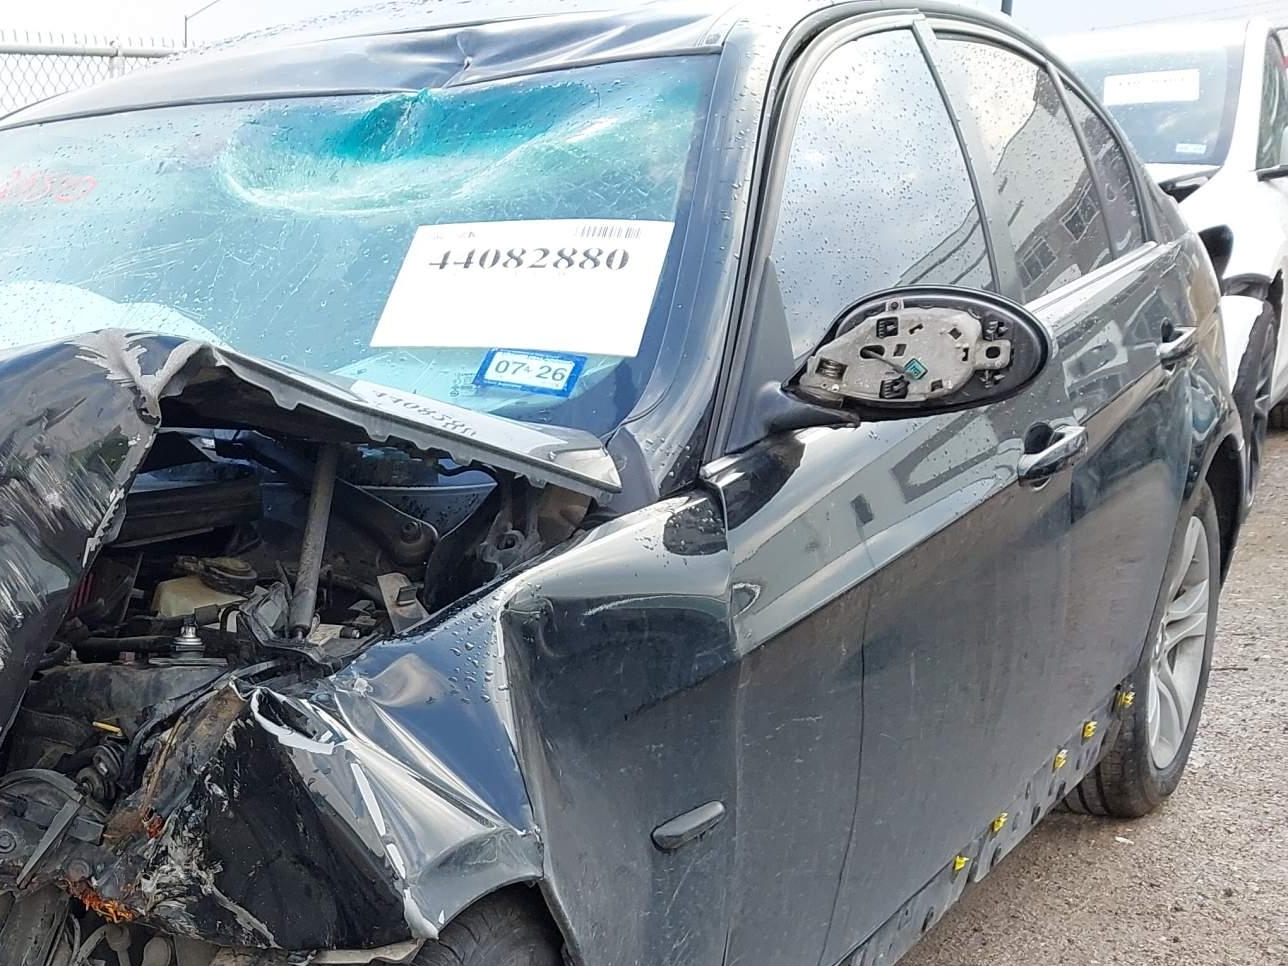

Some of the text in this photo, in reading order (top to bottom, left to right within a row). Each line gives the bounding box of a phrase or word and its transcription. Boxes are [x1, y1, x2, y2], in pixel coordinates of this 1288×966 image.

[429, 247, 630, 271] 44082880
[495, 360, 568, 382] 07 26
